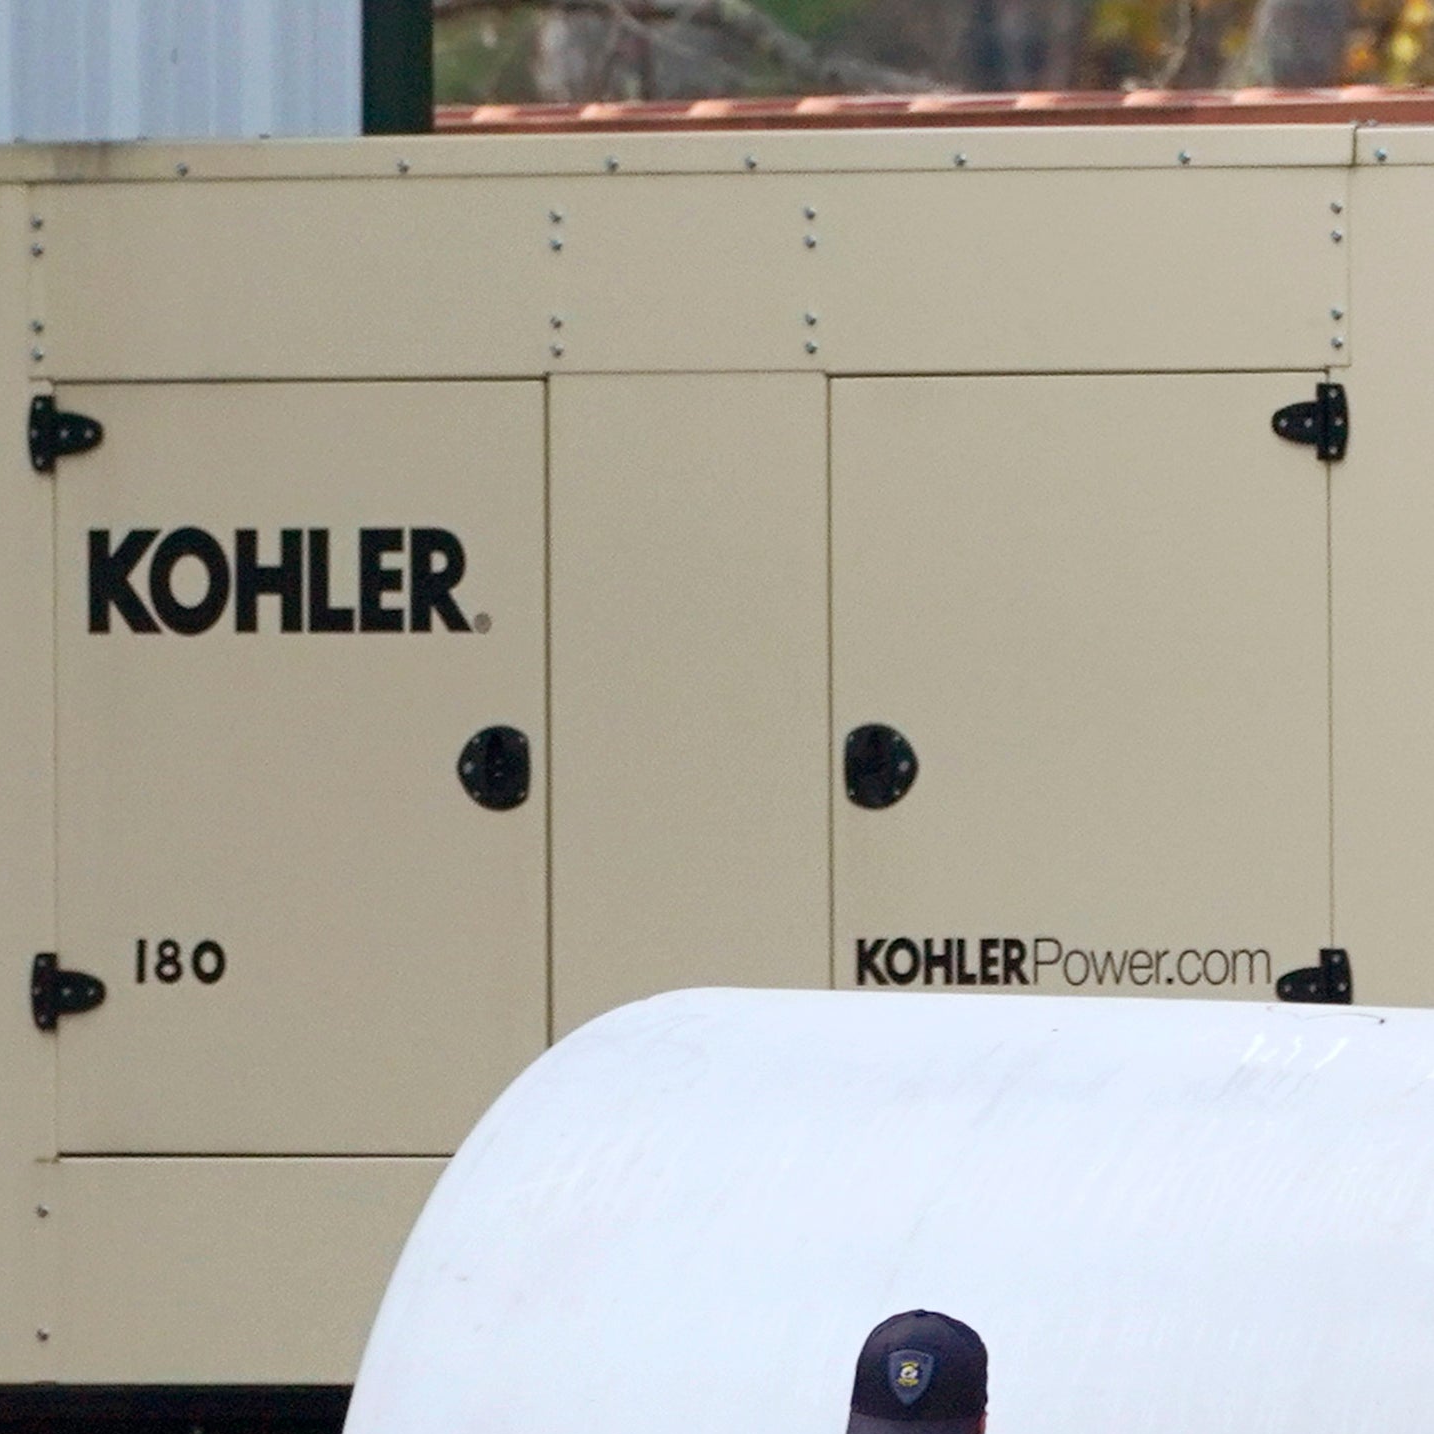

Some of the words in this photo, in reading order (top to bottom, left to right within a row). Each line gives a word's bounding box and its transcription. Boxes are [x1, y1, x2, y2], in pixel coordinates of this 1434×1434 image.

[88, 525, 474, 636] KOHLER
[136, 939, 227, 984] 180
[855, 936, 1272, 986] KOHLERPower.com
